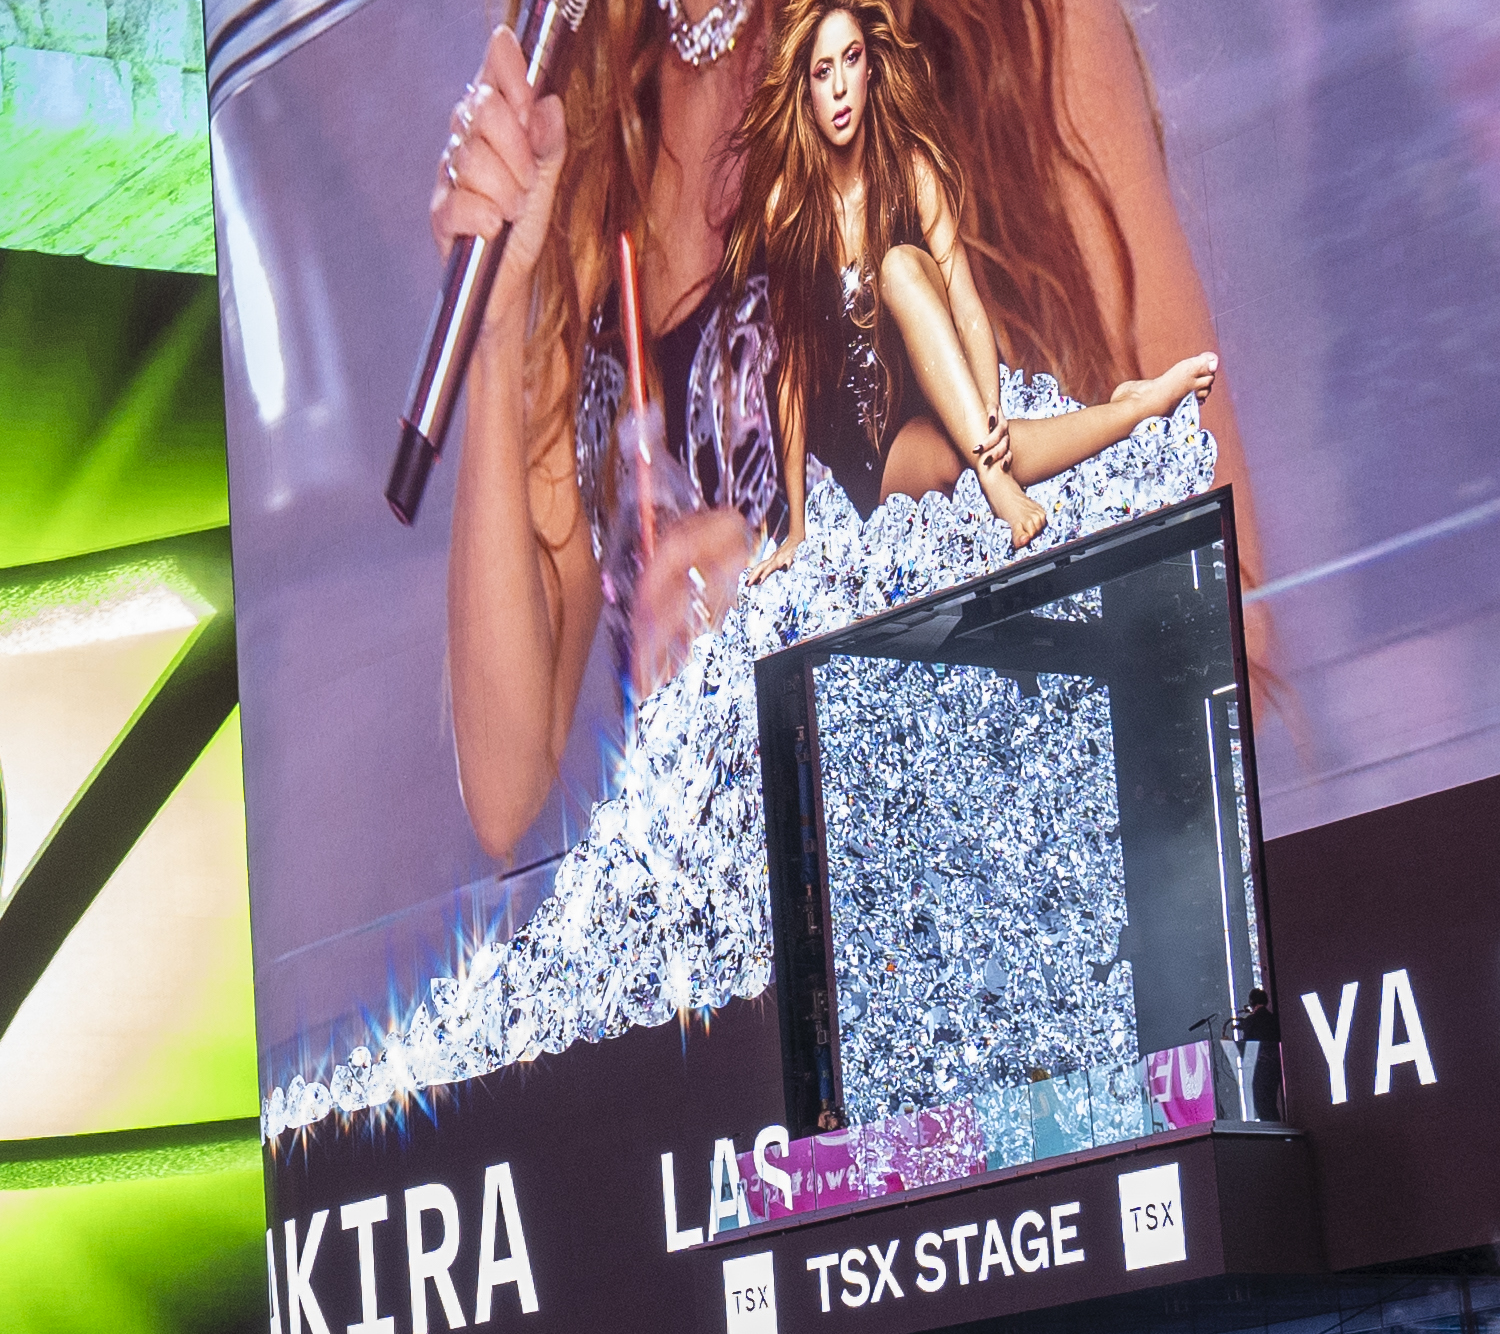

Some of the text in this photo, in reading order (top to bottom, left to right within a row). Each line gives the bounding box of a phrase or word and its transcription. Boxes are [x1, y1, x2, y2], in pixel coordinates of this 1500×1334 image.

[1301, 968, 1438, 1106] YA
[659, 1124, 794, 1254] LAS
[731, 1200, 1178, 1314] TSX TSX STAGE TSX
